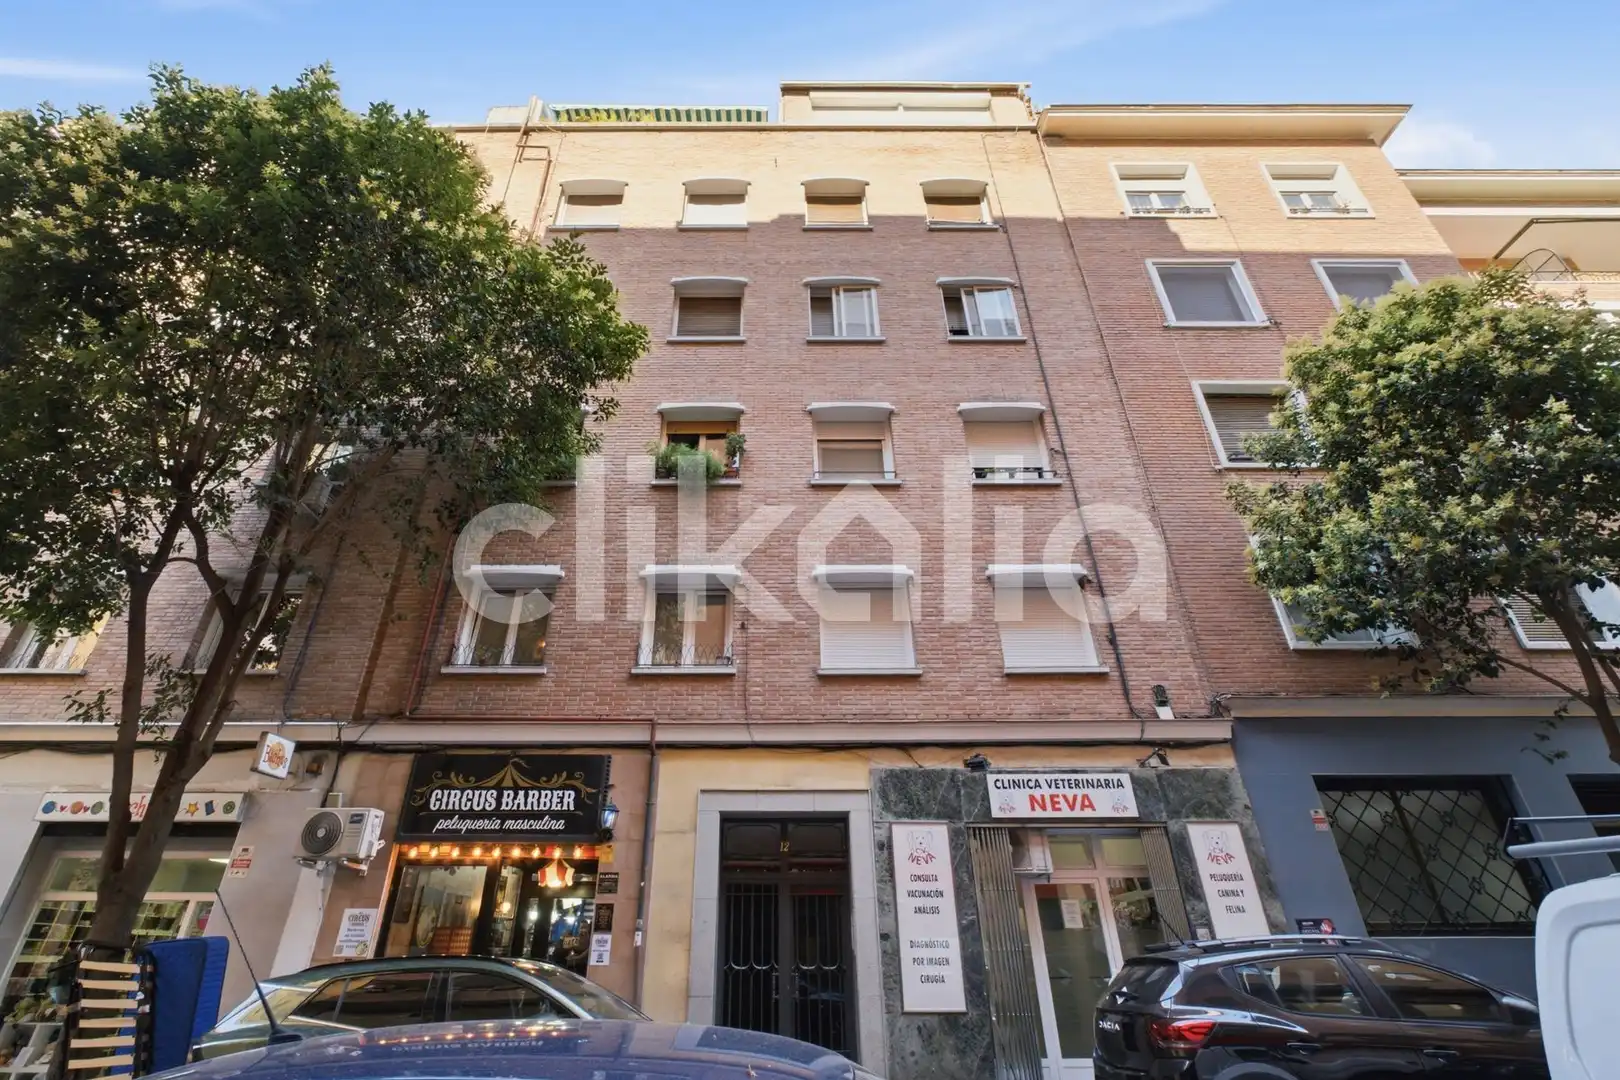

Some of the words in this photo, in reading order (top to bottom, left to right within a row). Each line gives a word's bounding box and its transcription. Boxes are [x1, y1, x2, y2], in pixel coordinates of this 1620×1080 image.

[994, 778, 1042, 790] CLINICA
[1045, 778, 1125, 790] VETERINARIA
[429, 789, 497, 811] CIRCUS
[500, 789, 576, 811] BARBER
[1028, 793, 1096, 812] NEVA
[432, 814, 501, 834] peluquería
[503, 814, 565, 830] masculina
[779, 841, 790, 852] 12
[907, 852, 936, 865] NEVA
[1207, 852, 1235, 865] NEVA
[910, 873, 938, 882] CONSULTA
[1209, 872, 1244, 882] PELUQUERÍA
[906, 888, 944, 898] VACUNACIÓN
[1217, 889, 1240, 898] CANINA
[914, 904, 940, 914] ANÁLISIS
[1225, 905, 1246, 914] FELINA
[909, 938, 950, 949] DIAGNÓSTICO
[912, 957, 925, 966] POR
[926, 957, 950, 966] IMAGEN
[920, 973, 945, 984] CIRUGÍA
[1098, 1020, 1120, 1031] DACIA
